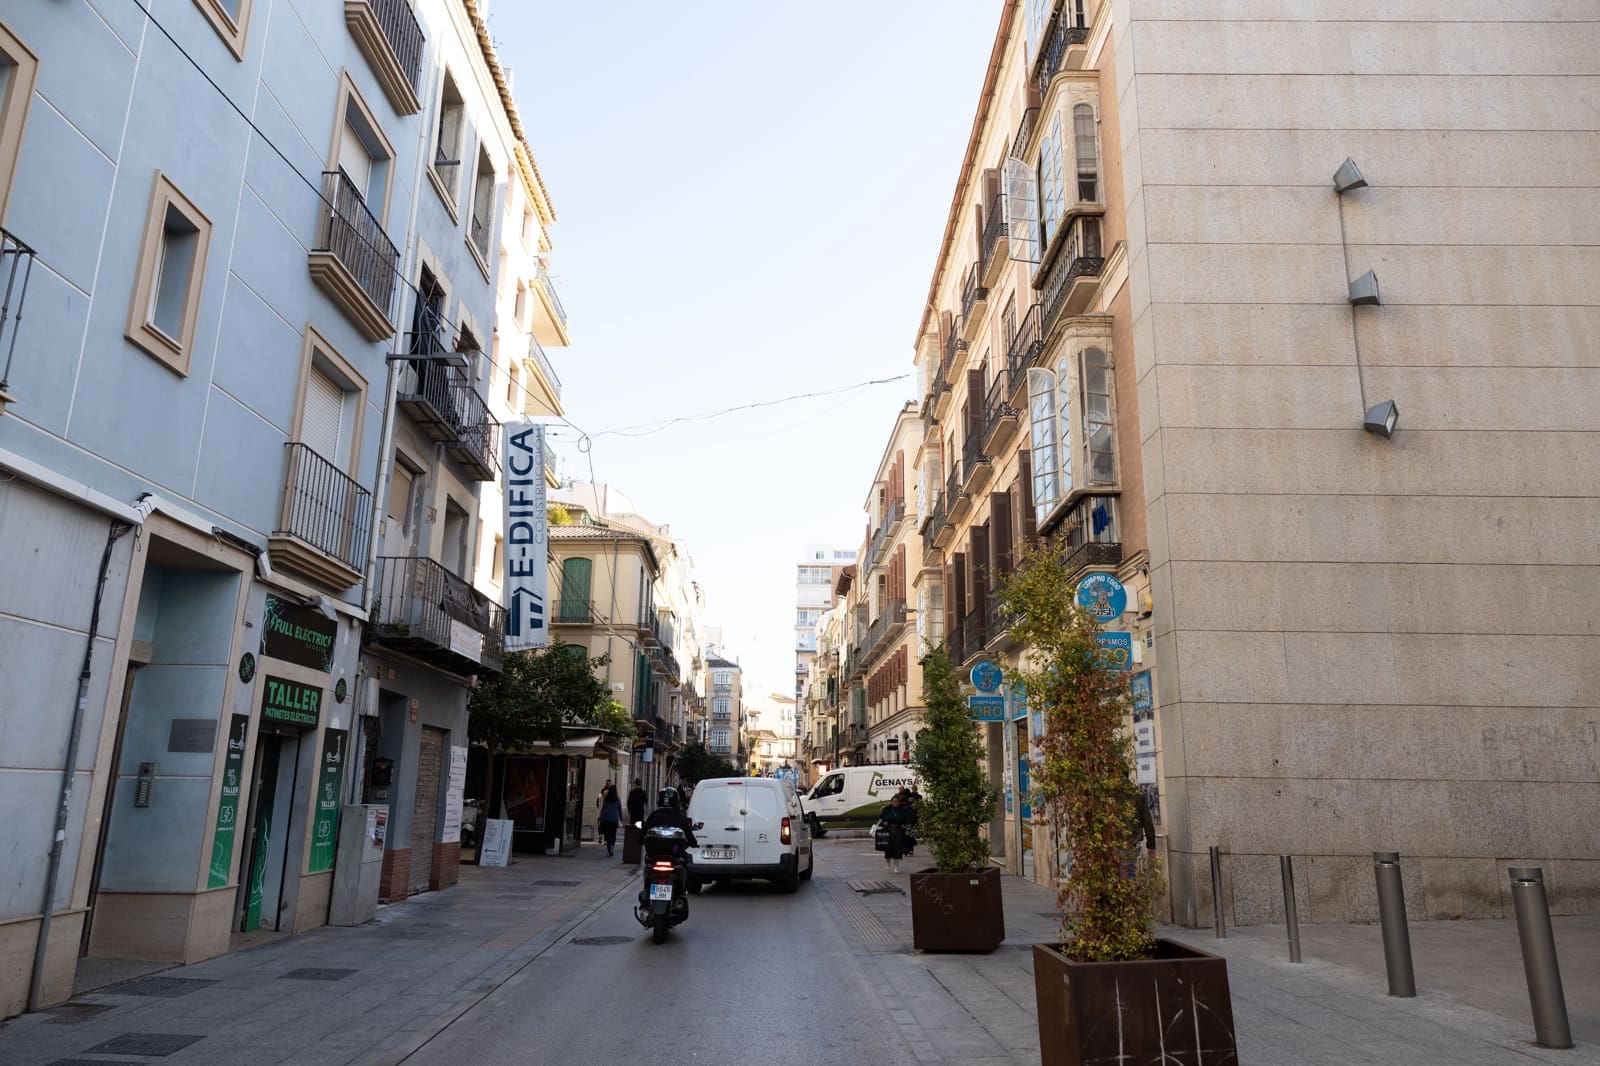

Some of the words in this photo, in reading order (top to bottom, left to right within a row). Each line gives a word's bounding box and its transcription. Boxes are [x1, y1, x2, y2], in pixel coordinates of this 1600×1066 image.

[509, 427, 534, 577] E-DIFICA
[1106, 576, 1121, 591] TODO
[274, 618, 294, 637] FULL
[294, 625, 329, 648] ELECTRIC
[1096, 638, 1128, 646] PRAMOS
[1096, 647, 1129, 665] RO
[268, 681, 318, 712] TALLER
[972, 705, 1003, 718] ORO
